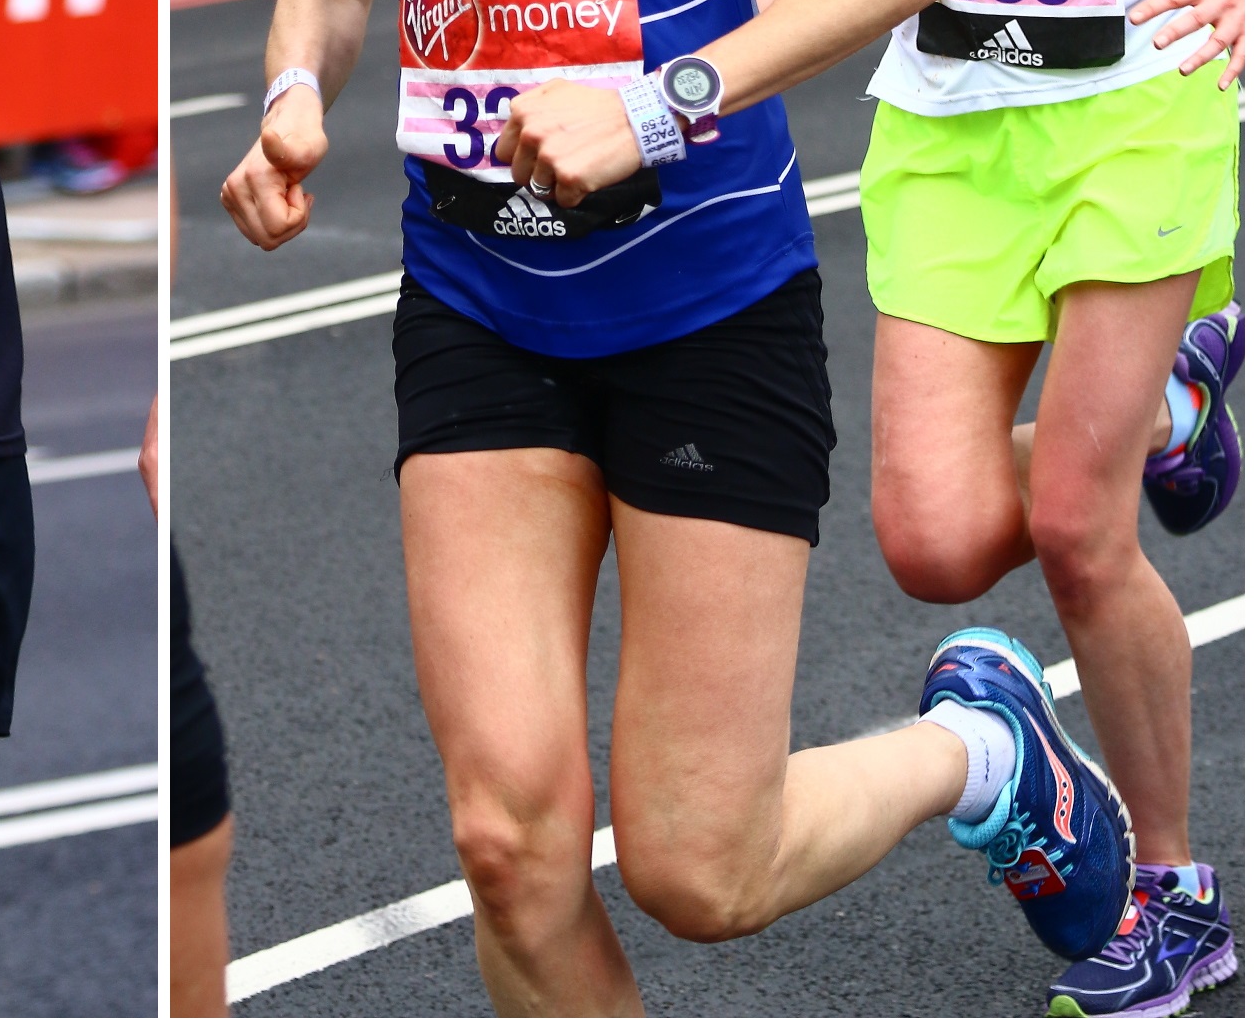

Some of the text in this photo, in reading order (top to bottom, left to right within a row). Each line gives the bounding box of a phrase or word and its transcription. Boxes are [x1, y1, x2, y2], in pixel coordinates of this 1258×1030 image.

[488, 0, 623, 36] money
[641, 115, 669, 132] 2:59
[642, 126, 677, 146] PACE
[494, 217, 567, 236] adidas
[659, 456, 714, 471] adidas
